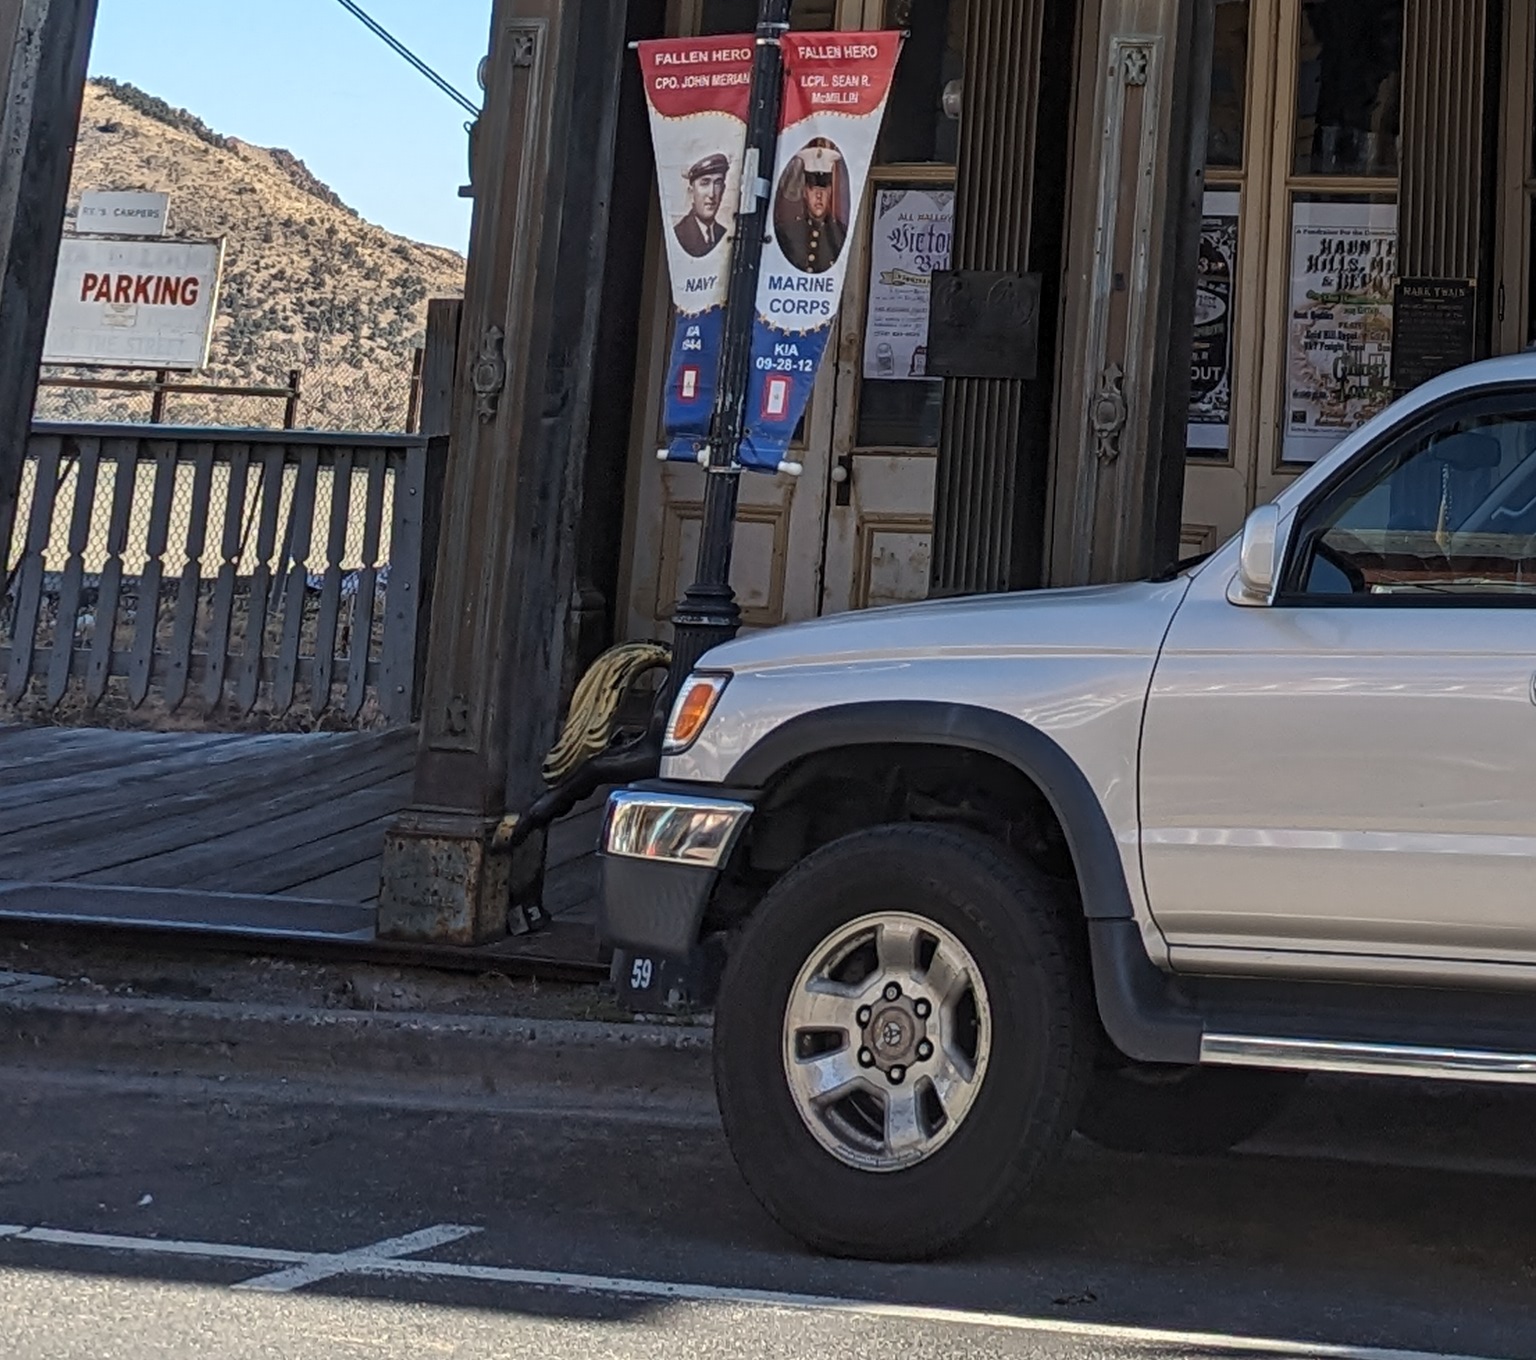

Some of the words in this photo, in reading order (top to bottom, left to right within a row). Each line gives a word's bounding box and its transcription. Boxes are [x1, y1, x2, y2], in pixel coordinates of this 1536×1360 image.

[655, 50, 709, 66] FALLEN
[712, 48, 752, 62] HERO
[798, 45, 842, 60] FALLEN
[843, 45, 878, 60] HERO
[681, 74, 710, 89] JOHN
[831, 75, 860, 87] SEAN
[80, 272, 199, 306] PARKING
[684, 275, 718, 293] NAVY
[768, 275, 835, 293] MARINE
[769, 298, 831, 316] CORPS
[774, 343, 799, 357] KIA
[756, 357, 813, 372] 09-28-12
[630, 958, 653, 989] 59
